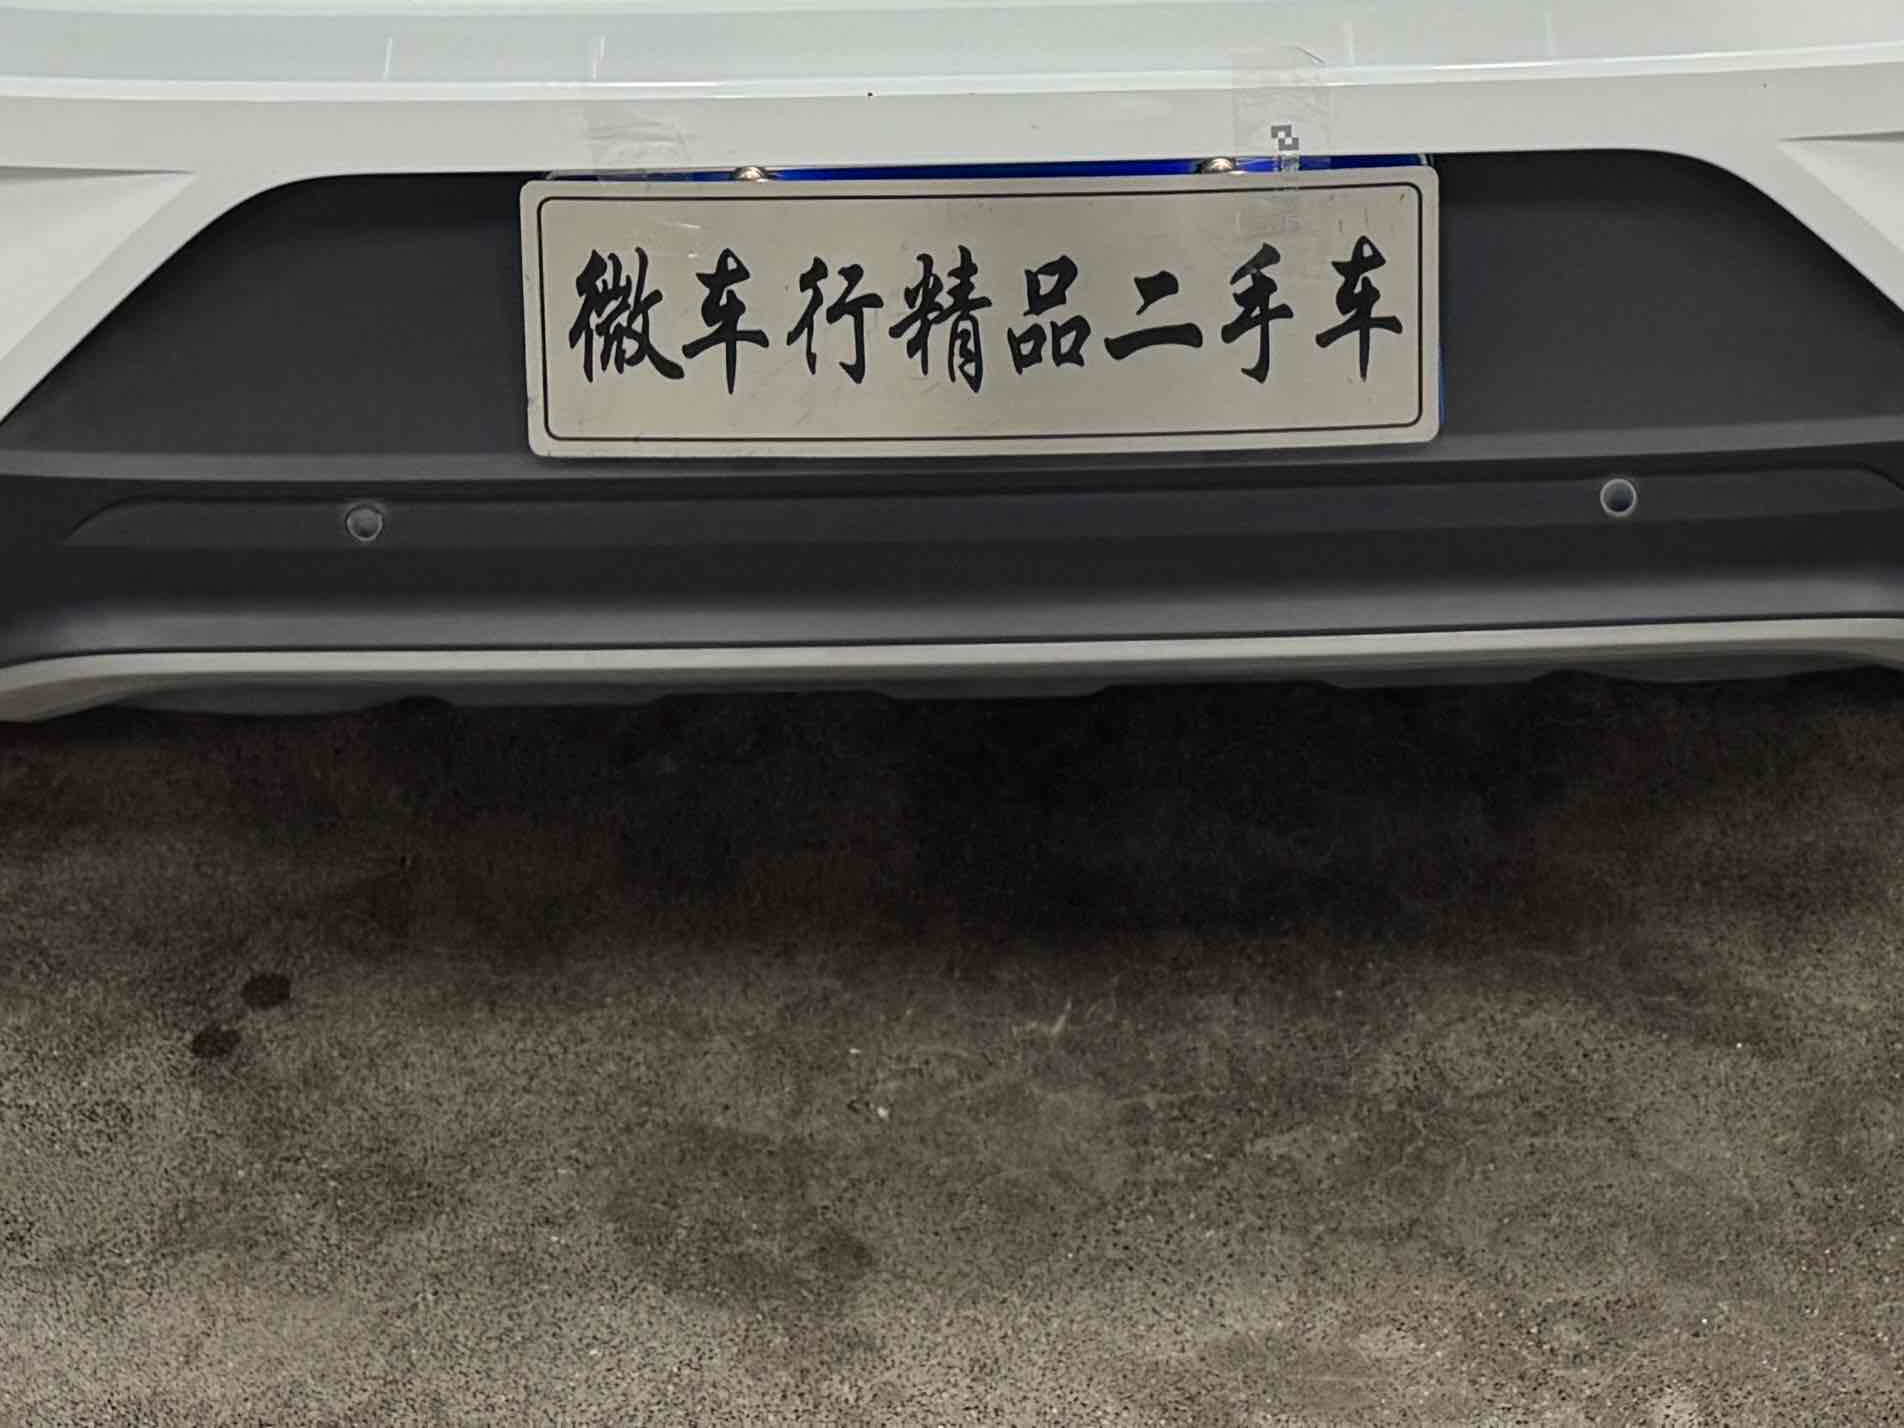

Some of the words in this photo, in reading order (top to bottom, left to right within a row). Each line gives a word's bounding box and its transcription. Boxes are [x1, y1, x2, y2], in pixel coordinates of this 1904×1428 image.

[568, 236, 1404, 395] 微车行精品二手车
